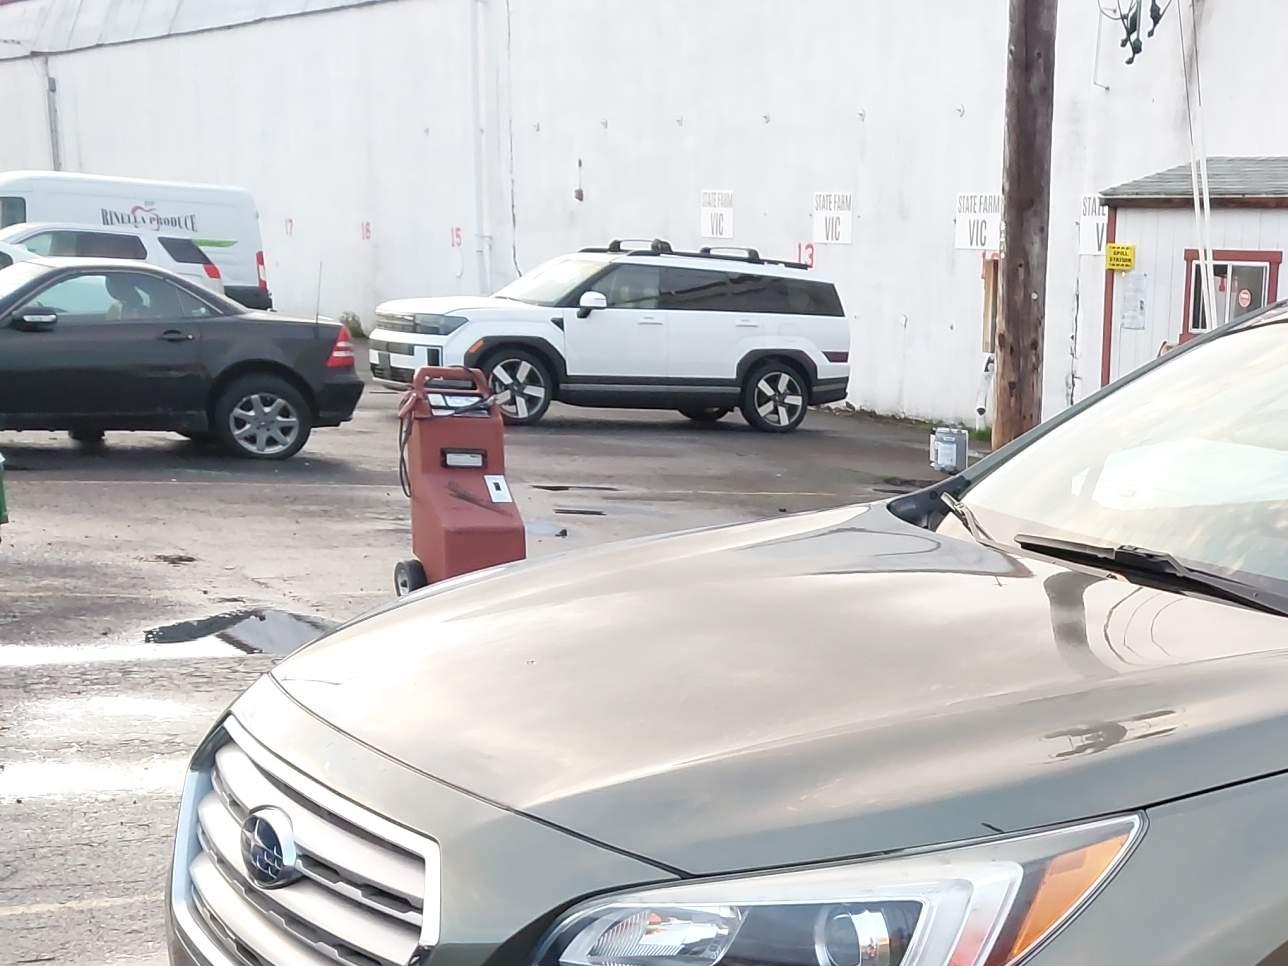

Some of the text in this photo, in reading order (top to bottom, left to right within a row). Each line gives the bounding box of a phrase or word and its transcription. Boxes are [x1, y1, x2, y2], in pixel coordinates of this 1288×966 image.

[702, 191, 717, 208] STATE
[815, 194, 851, 211] STATE FARM
[958, 195, 1000, 213] STATE FARM
[710, 212, 724, 236] VIC
[824, 215, 841, 241] VIC
[968, 219, 987, 247] VIC
[450, 226, 463, 248] 15
[797, 242, 814, 268] 13
